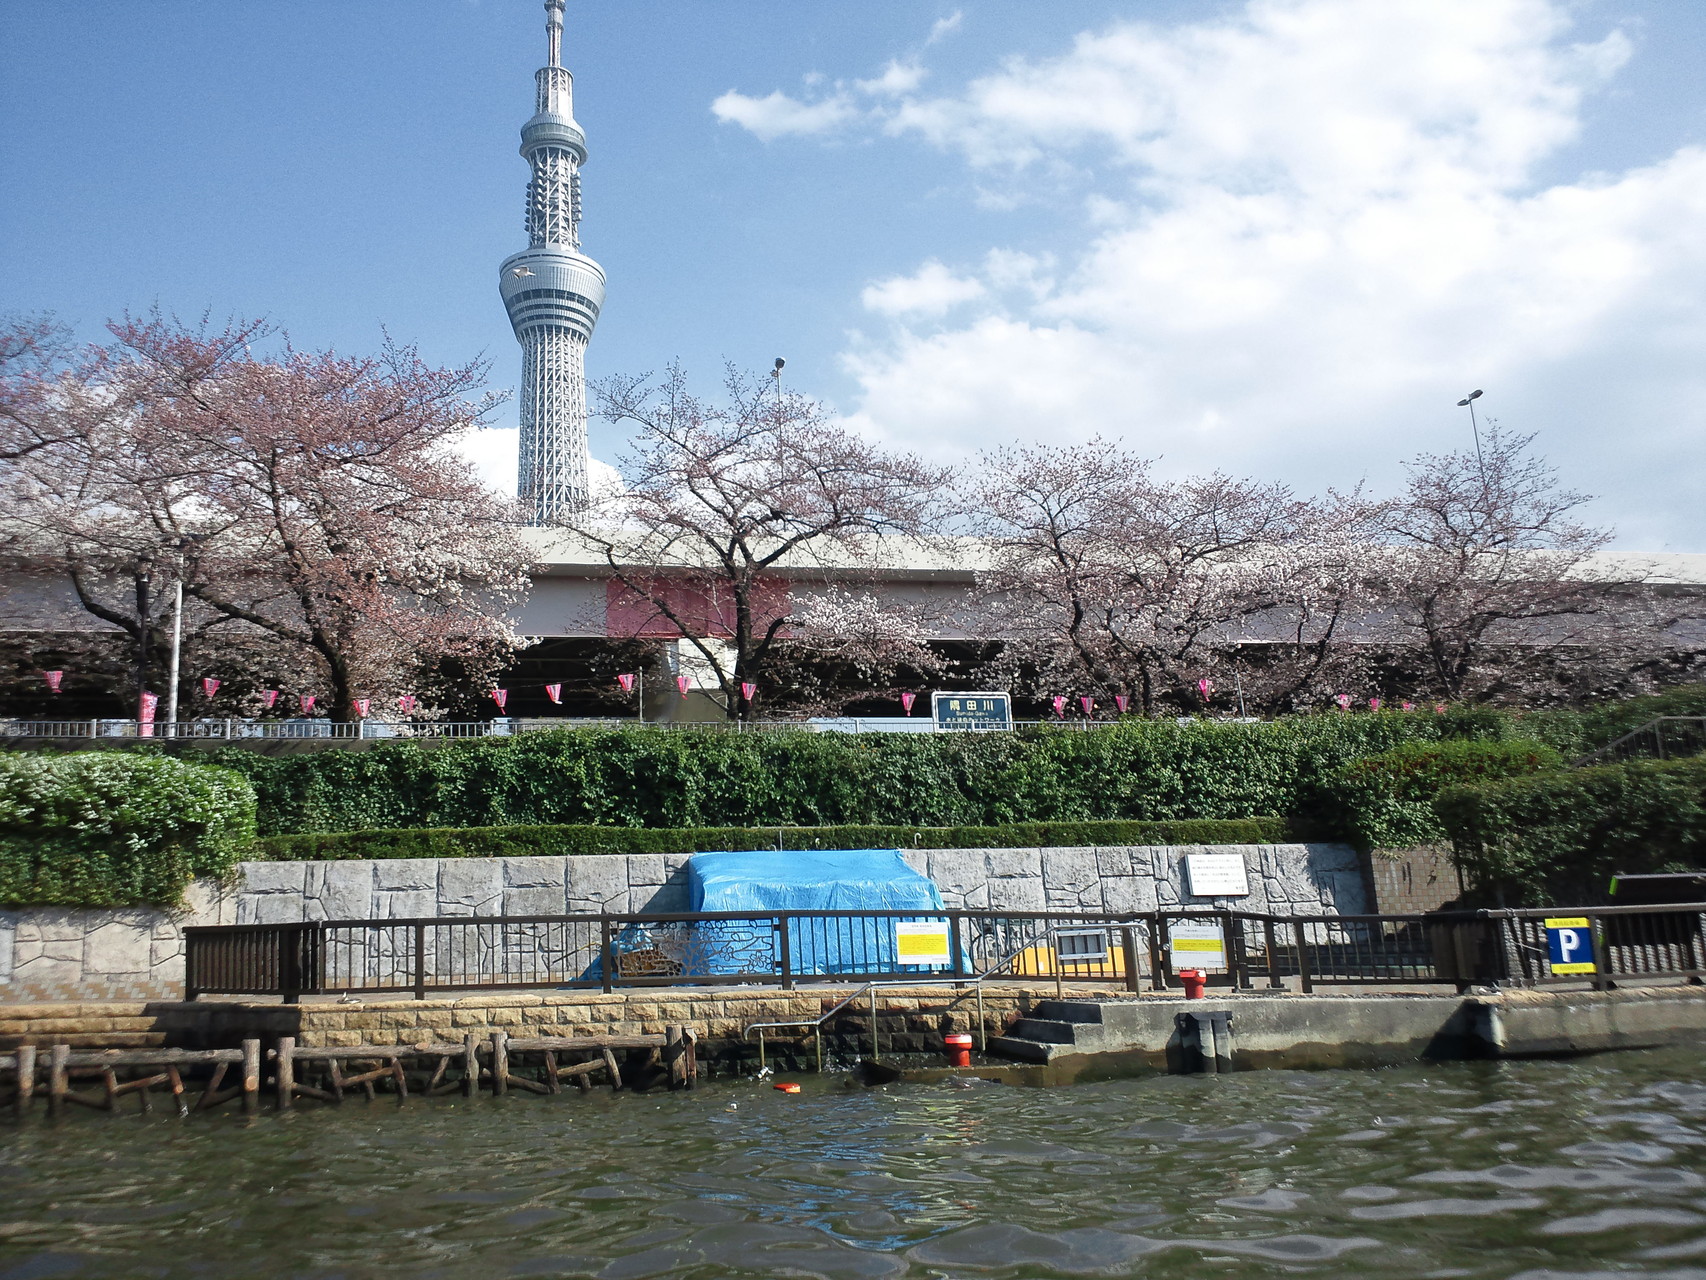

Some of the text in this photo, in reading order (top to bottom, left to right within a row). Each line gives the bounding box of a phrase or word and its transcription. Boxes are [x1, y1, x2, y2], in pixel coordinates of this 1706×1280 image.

[949, 700, 994, 711] 隅田川
[1559, 929, 1580, 962] P
